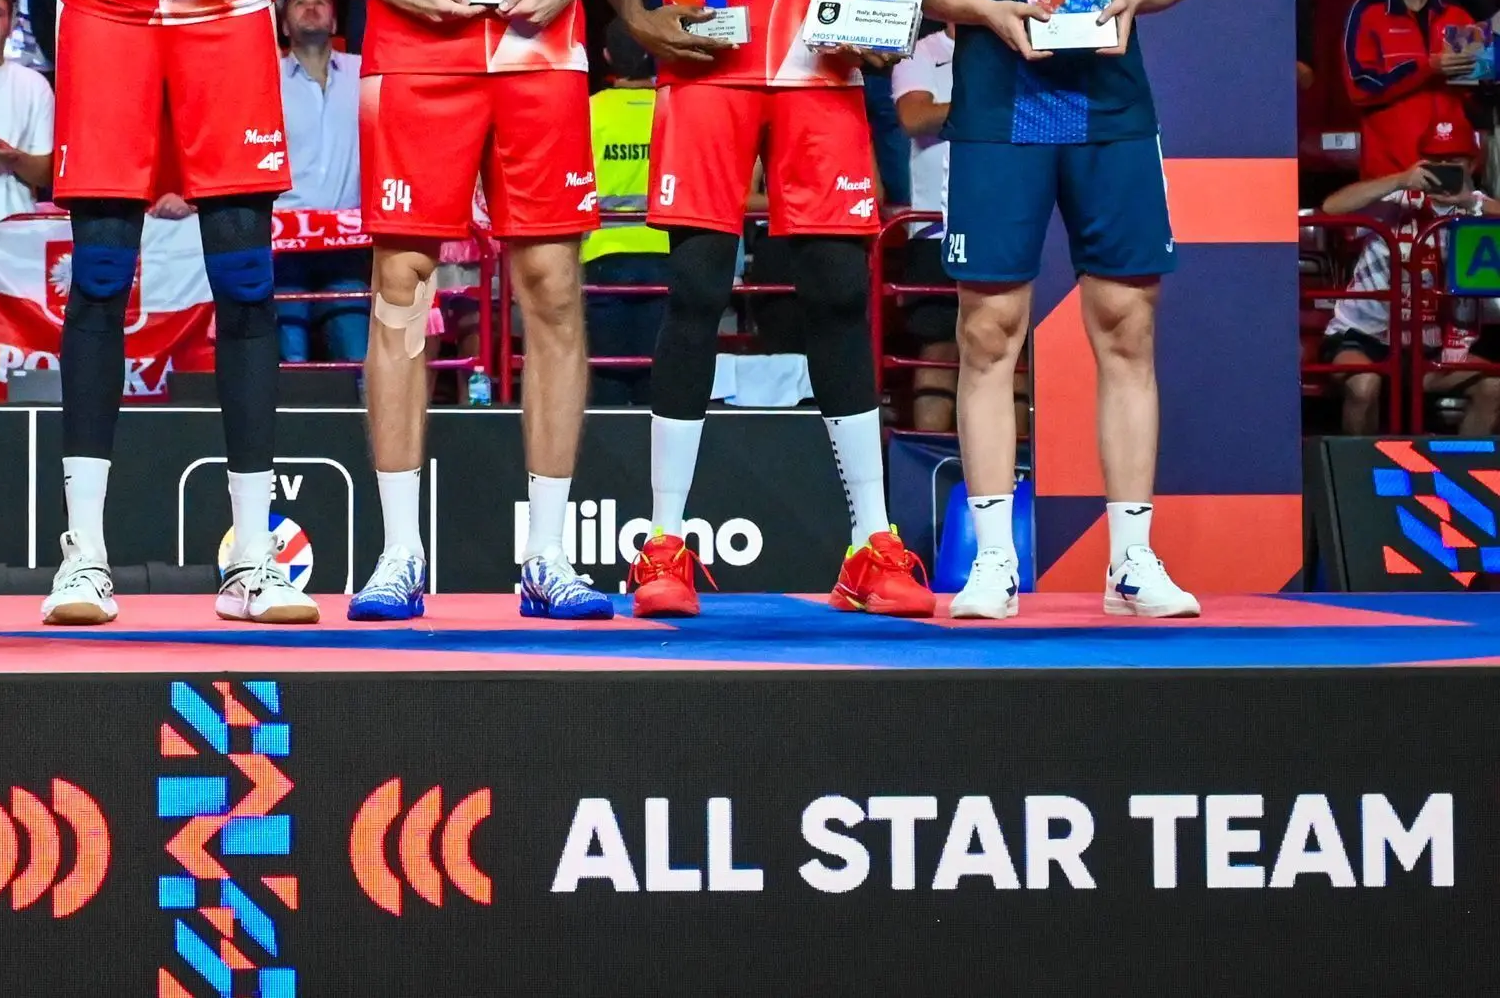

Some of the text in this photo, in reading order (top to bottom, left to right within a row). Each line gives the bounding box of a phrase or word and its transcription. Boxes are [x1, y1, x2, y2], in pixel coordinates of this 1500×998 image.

[812, 32, 835, 40] MOST
[836, 34, 872, 43] VALUABLE
[257, 151, 285, 172] 4F
[603, 143, 650, 161] ASSIST
[381, 178, 412, 212] 34
[660, 174, 675, 206] 9
[849, 197, 874, 218] 4F
[947, 233, 967, 263] 24
[1466, 235, 1500, 278] A
[552, 794, 1454, 893] ALL STAR TEAM
